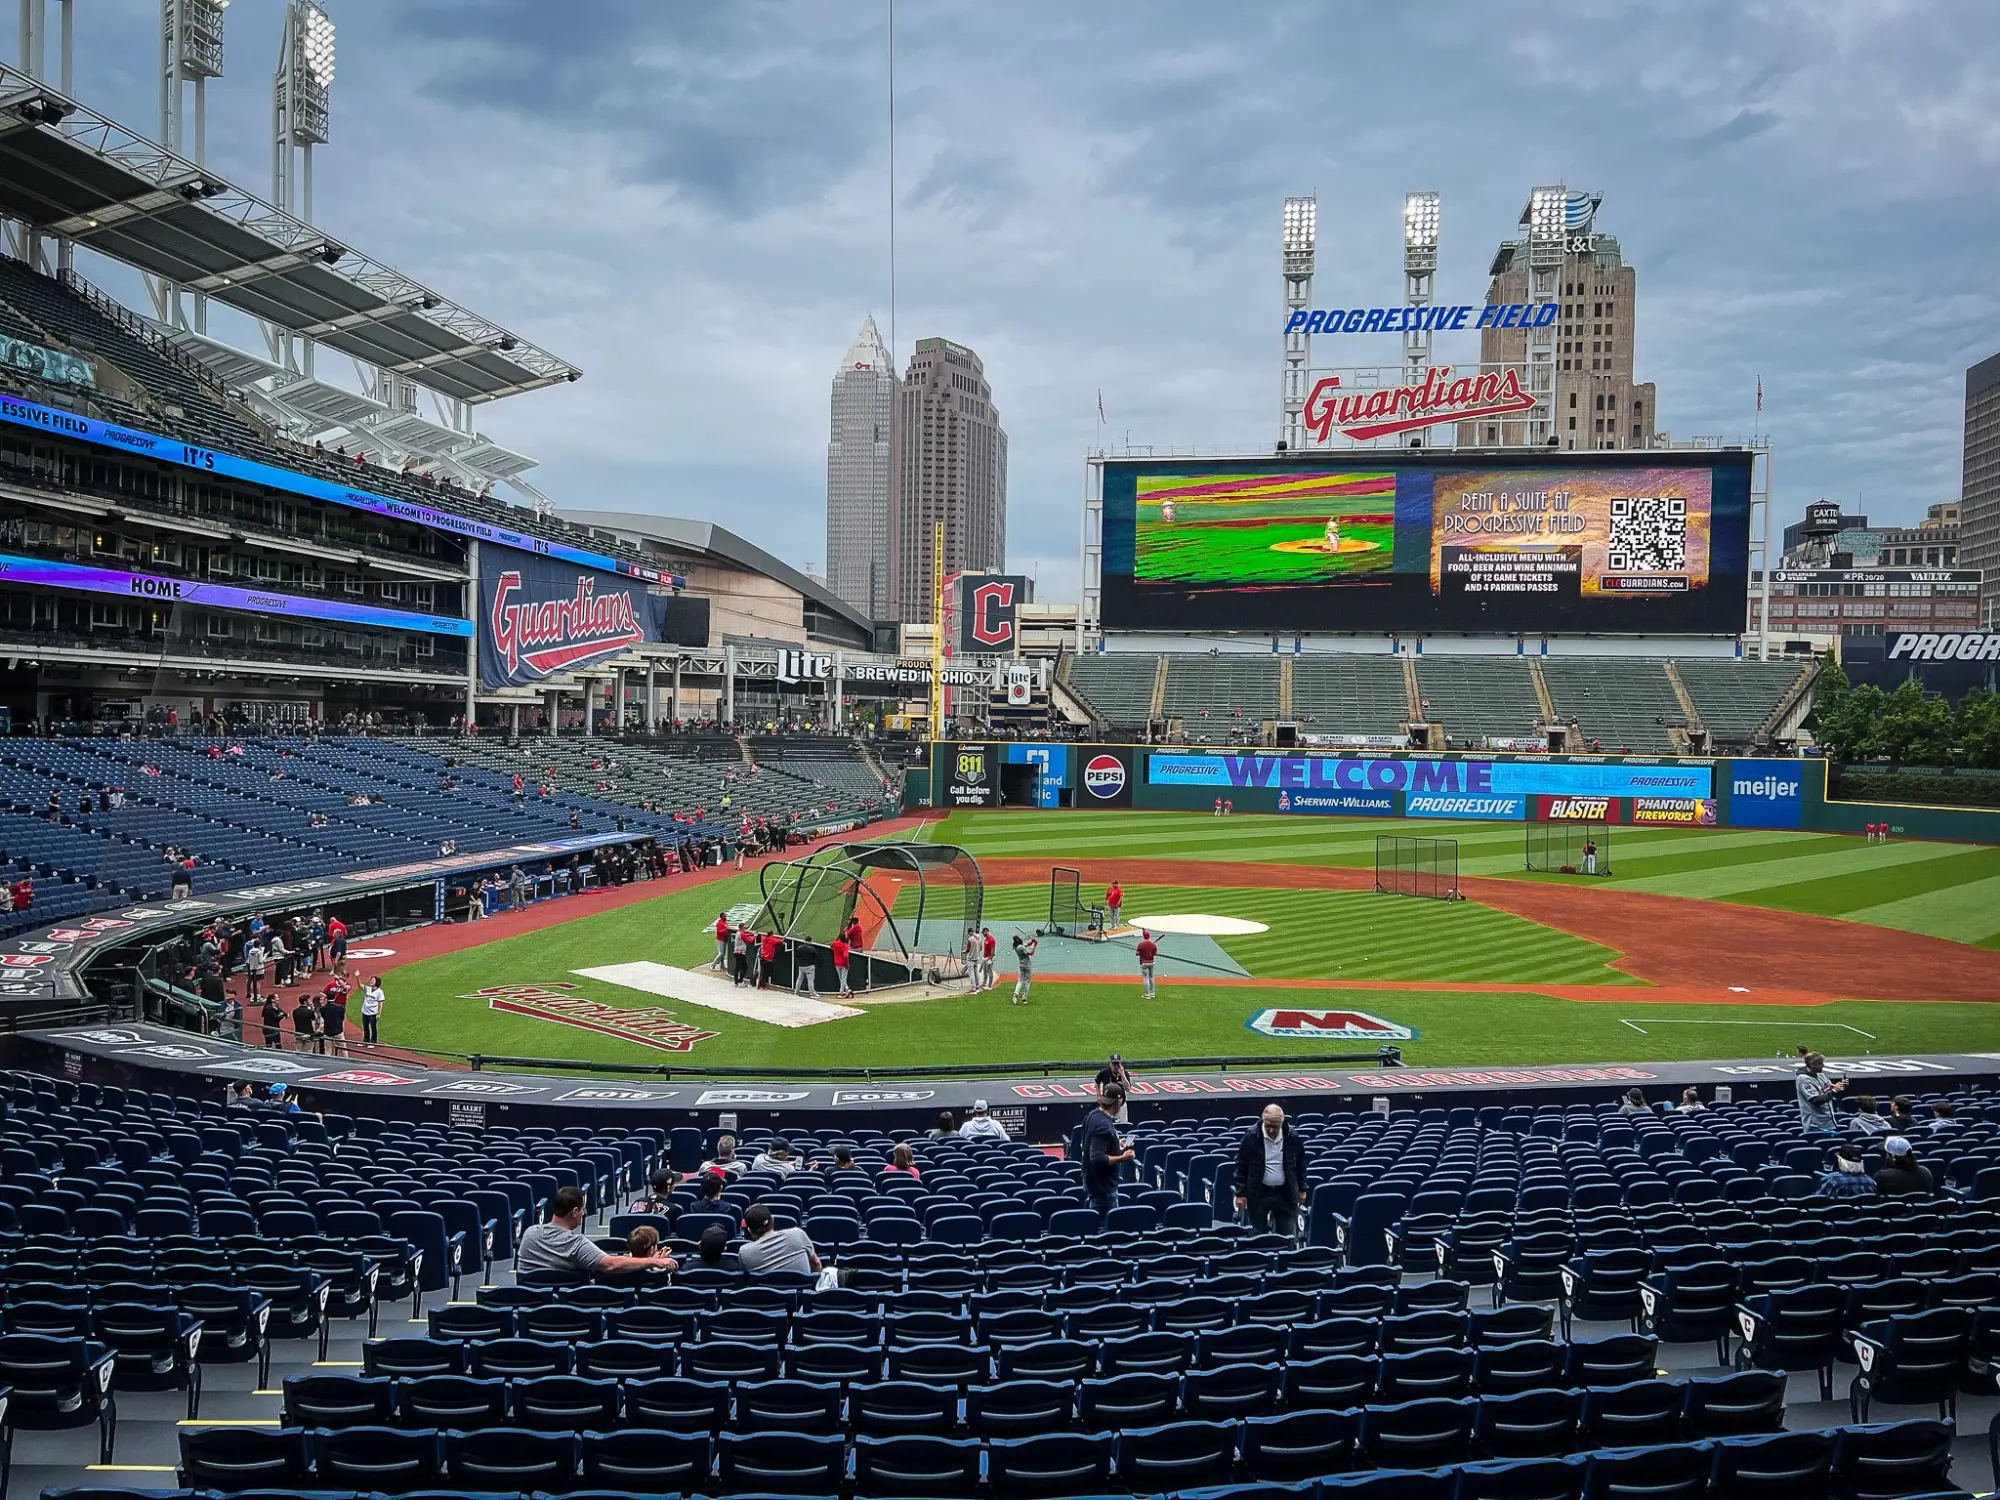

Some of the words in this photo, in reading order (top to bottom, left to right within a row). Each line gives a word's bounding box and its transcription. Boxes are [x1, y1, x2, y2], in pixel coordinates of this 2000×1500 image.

[1562, 232, 1596, 253] t&t
[1284, 305, 1474, 334] PROGRESSIVE
[1475, 303, 1558, 328] FIELD
[1303, 366, 1537, 445] Guardians
[2, 402, 49, 425] ESSIVE
[53, 415, 88, 434] FIELD
[103, 429, 156, 450] PROGRESSIVE
[184, 446, 214, 469] IT'S
[344, 492, 379, 508] PROGRESSIVE
[1462, 492, 1493, 511] RENT
[1500, 492, 1508, 511] A
[1516, 492, 1548, 510] SUITE
[1555, 492, 1569, 510] AT
[386, 501, 420, 521] WELCOME
[422, 509, 431, 522] TO
[432, 511, 476, 534] PROGRESSIVE
[476, 523, 492, 537] FIELD
[1444, 515, 1543, 534] PROGRESSIVE
[1550, 514, 1586, 532] FIELD
[533, 539, 548, 554] IT'S
[1458, 553, 1517, 562] ALL-INCLUSIVE
[1520, 553, 1542, 562] MENU
[1544, 553, 1566, 562] WITH
[1448, 563, 1472, 572] FOOD,
[1474, 563, 1494, 572] BEER
[1496, 563, 1512, 572] AND
[1514, 563, 1534, 572] WINE
[1536, 563, 1576, 572] MINIMUM
[1471, 573, 1481, 582] OF
[1483, 573, 1492, 582] 12
[1493, 573, 1517, 582] GAME
[1519, 573, 1553, 582] TICKETS
[1852, 572, 1864, 581] PR
[131, 577, 181, 598] HOME
[1464, 583, 1482, 592] AND
[1483, 583, 1489, 592] 4
[1491, 583, 1525, 592] PARKING
[1527, 583, 1558, 592] PASSES
[246, 595, 287, 609] PROGRESSIVE
[972, 582, 1014, 645] C
[492, 570, 644, 678] Guardians
[775, 649, 833, 684] Lite
[856, 667, 918, 682] BREWED
[922, 670, 935, 682] IN
[940, 671, 974, 684] OHIO
[1010, 672, 1030, 684] Lite
[959, 755, 982, 772] 811
[1159, 764, 1220, 776] PROGRESSIVE
[1088, 772, 1122, 782] PEPSI
[1222, 757, 1492, 793] WELCOME
[1629, 776, 1698, 788] PROGRESSIVE
[950, 786, 964, 794] Call
[966, 786, 990, 794] before
[1734, 776, 1798, 800] meijer
[956, 796, 970, 804] you
[970, 795, 984, 804] dig.
[1408, 797, 1517, 815] PROGRESSIVE
[1637, 799, 1695, 811] PHANTOM
[1549, 800, 1608, 819] BLASTER
[1636, 811, 1694, 821] FIREWORKS
[460, 983, 721, 1051] Guardians
[1271, 1011, 1394, 1031] M
[1273, 1028, 1405, 1038] Marathon
[1348, 1067, 1658, 1088] GUARDIANS
[447, 1083, 518, 1093] 2017
[574, 1089, 653, 1100] 2018
[704, 1091, 790, 1102] 2020
[842, 1091, 918, 1102] 2022
